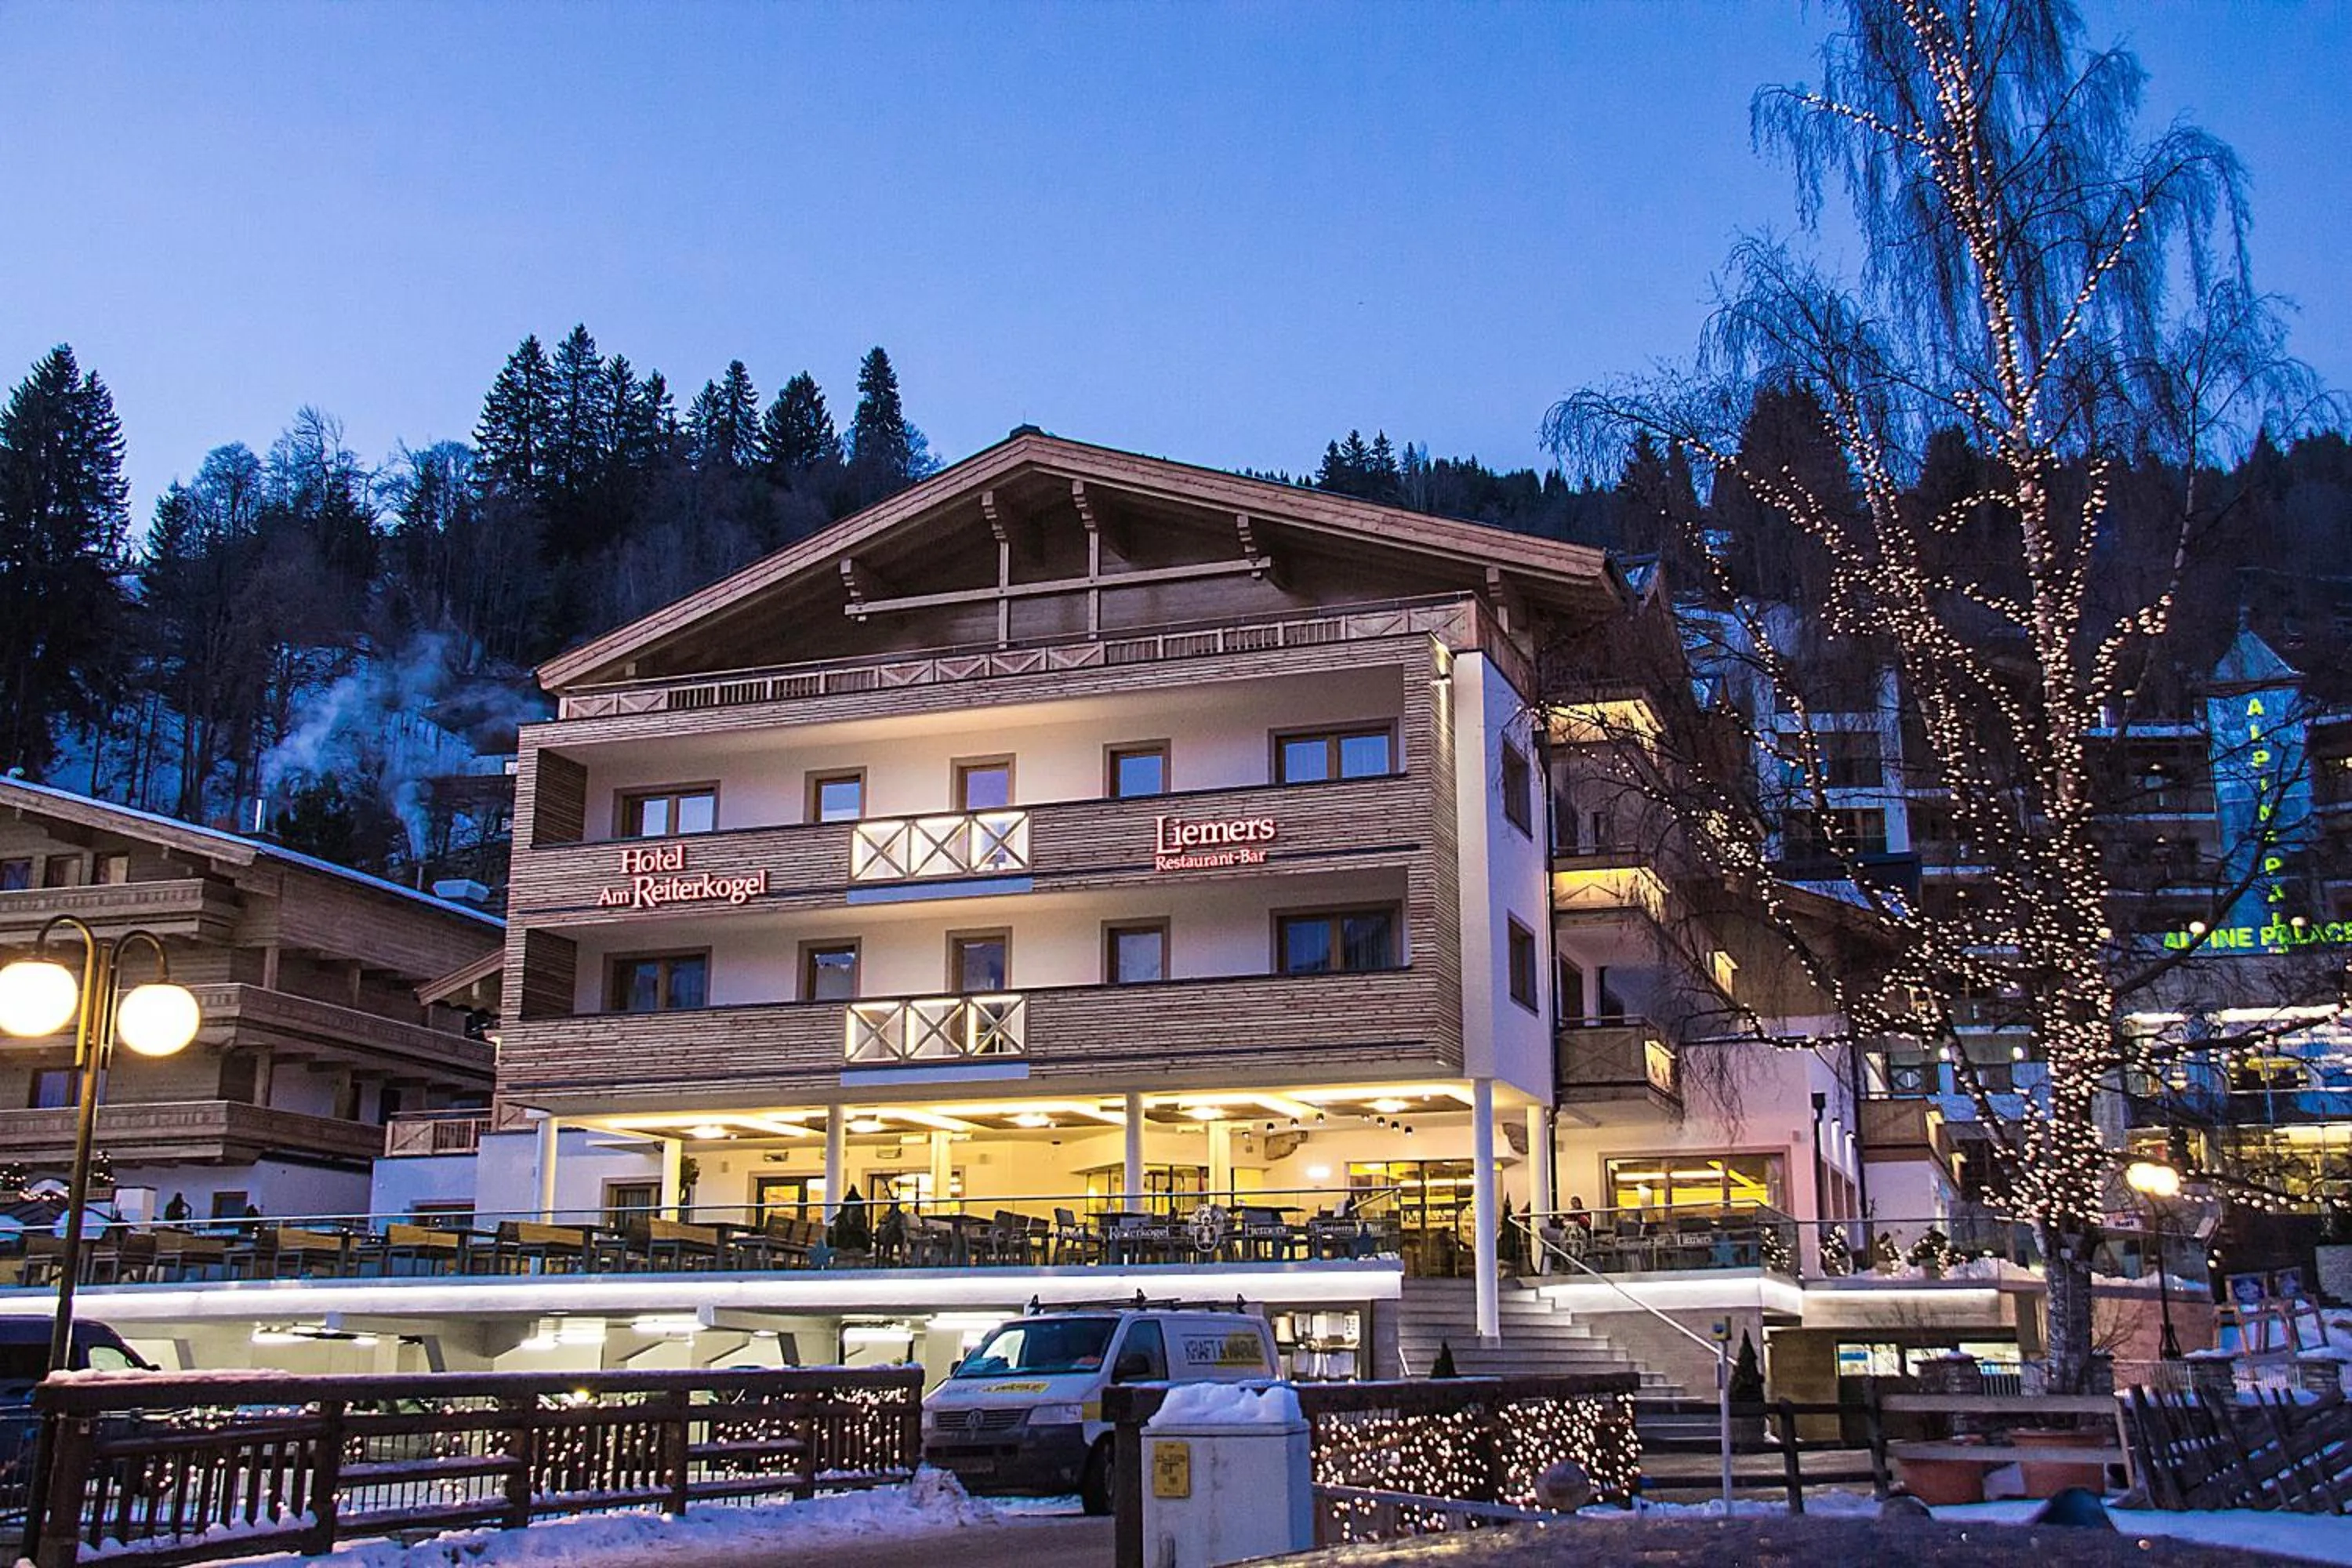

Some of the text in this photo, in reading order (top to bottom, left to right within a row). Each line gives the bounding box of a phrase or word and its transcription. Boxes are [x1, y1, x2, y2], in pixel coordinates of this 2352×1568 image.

[1155, 815, 1276, 853] Liemers
[619, 844, 684, 873] Hotel
[1155, 849, 1266, 871] Restaurant-Bar
[597, 869, 768, 908] Am Reiterkogel
[2164, 927, 2254, 949] ALINE
